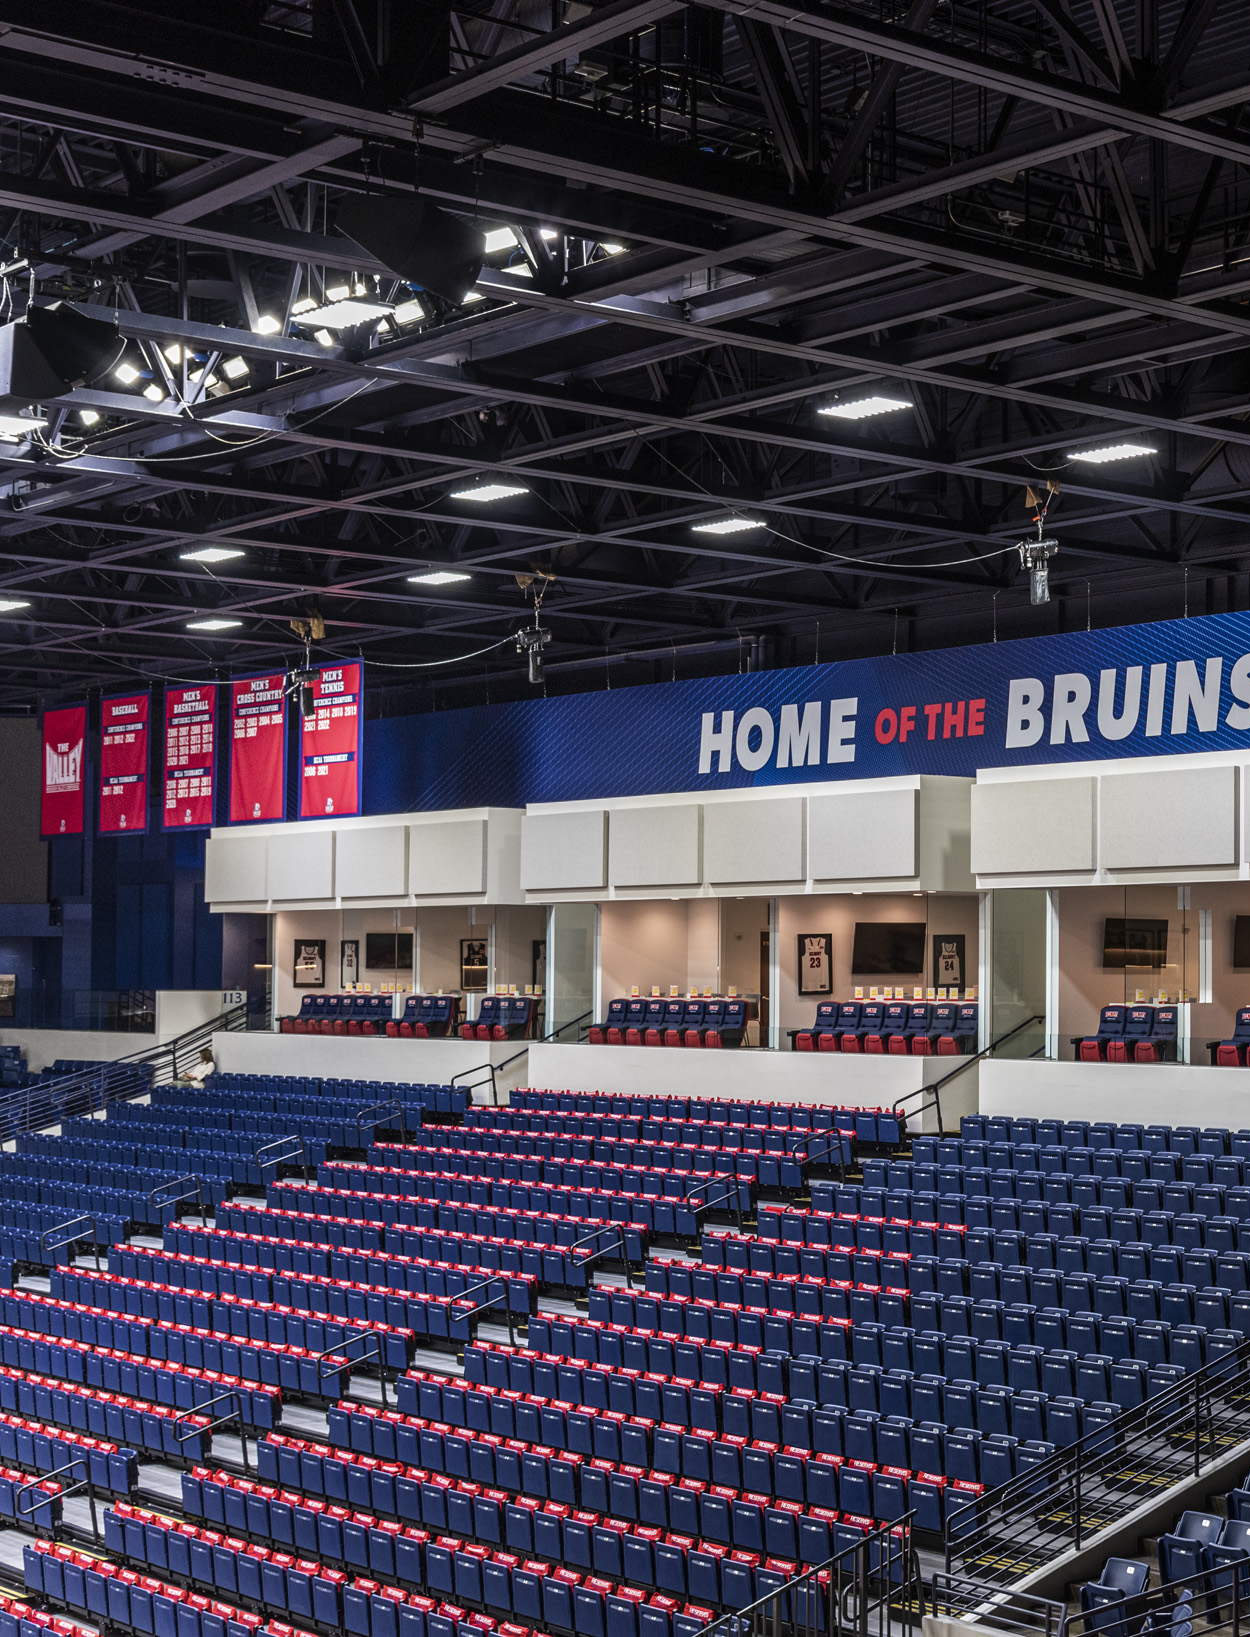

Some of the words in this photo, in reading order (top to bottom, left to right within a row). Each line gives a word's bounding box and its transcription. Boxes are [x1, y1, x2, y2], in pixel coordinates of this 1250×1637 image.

[321, 682, 344, 694] TENNIS
[237, 693, 254, 705] CROSS
[256, 689, 283, 702] COUNTRY
[112, 704, 138, 716] BASEBALL
[174, 701, 209, 714] BASKETBALL
[698, 696, 858, 775] HOME
[874, 706, 916, 746] OF
[922, 698, 986, 742] THE
[57, 743, 69, 752] THE
[46, 738, 83, 785] VALLEY
[810, 957, 821, 968] 23
[945, 961, 954, 970] 24
[223, 993, 242, 1003] 113
